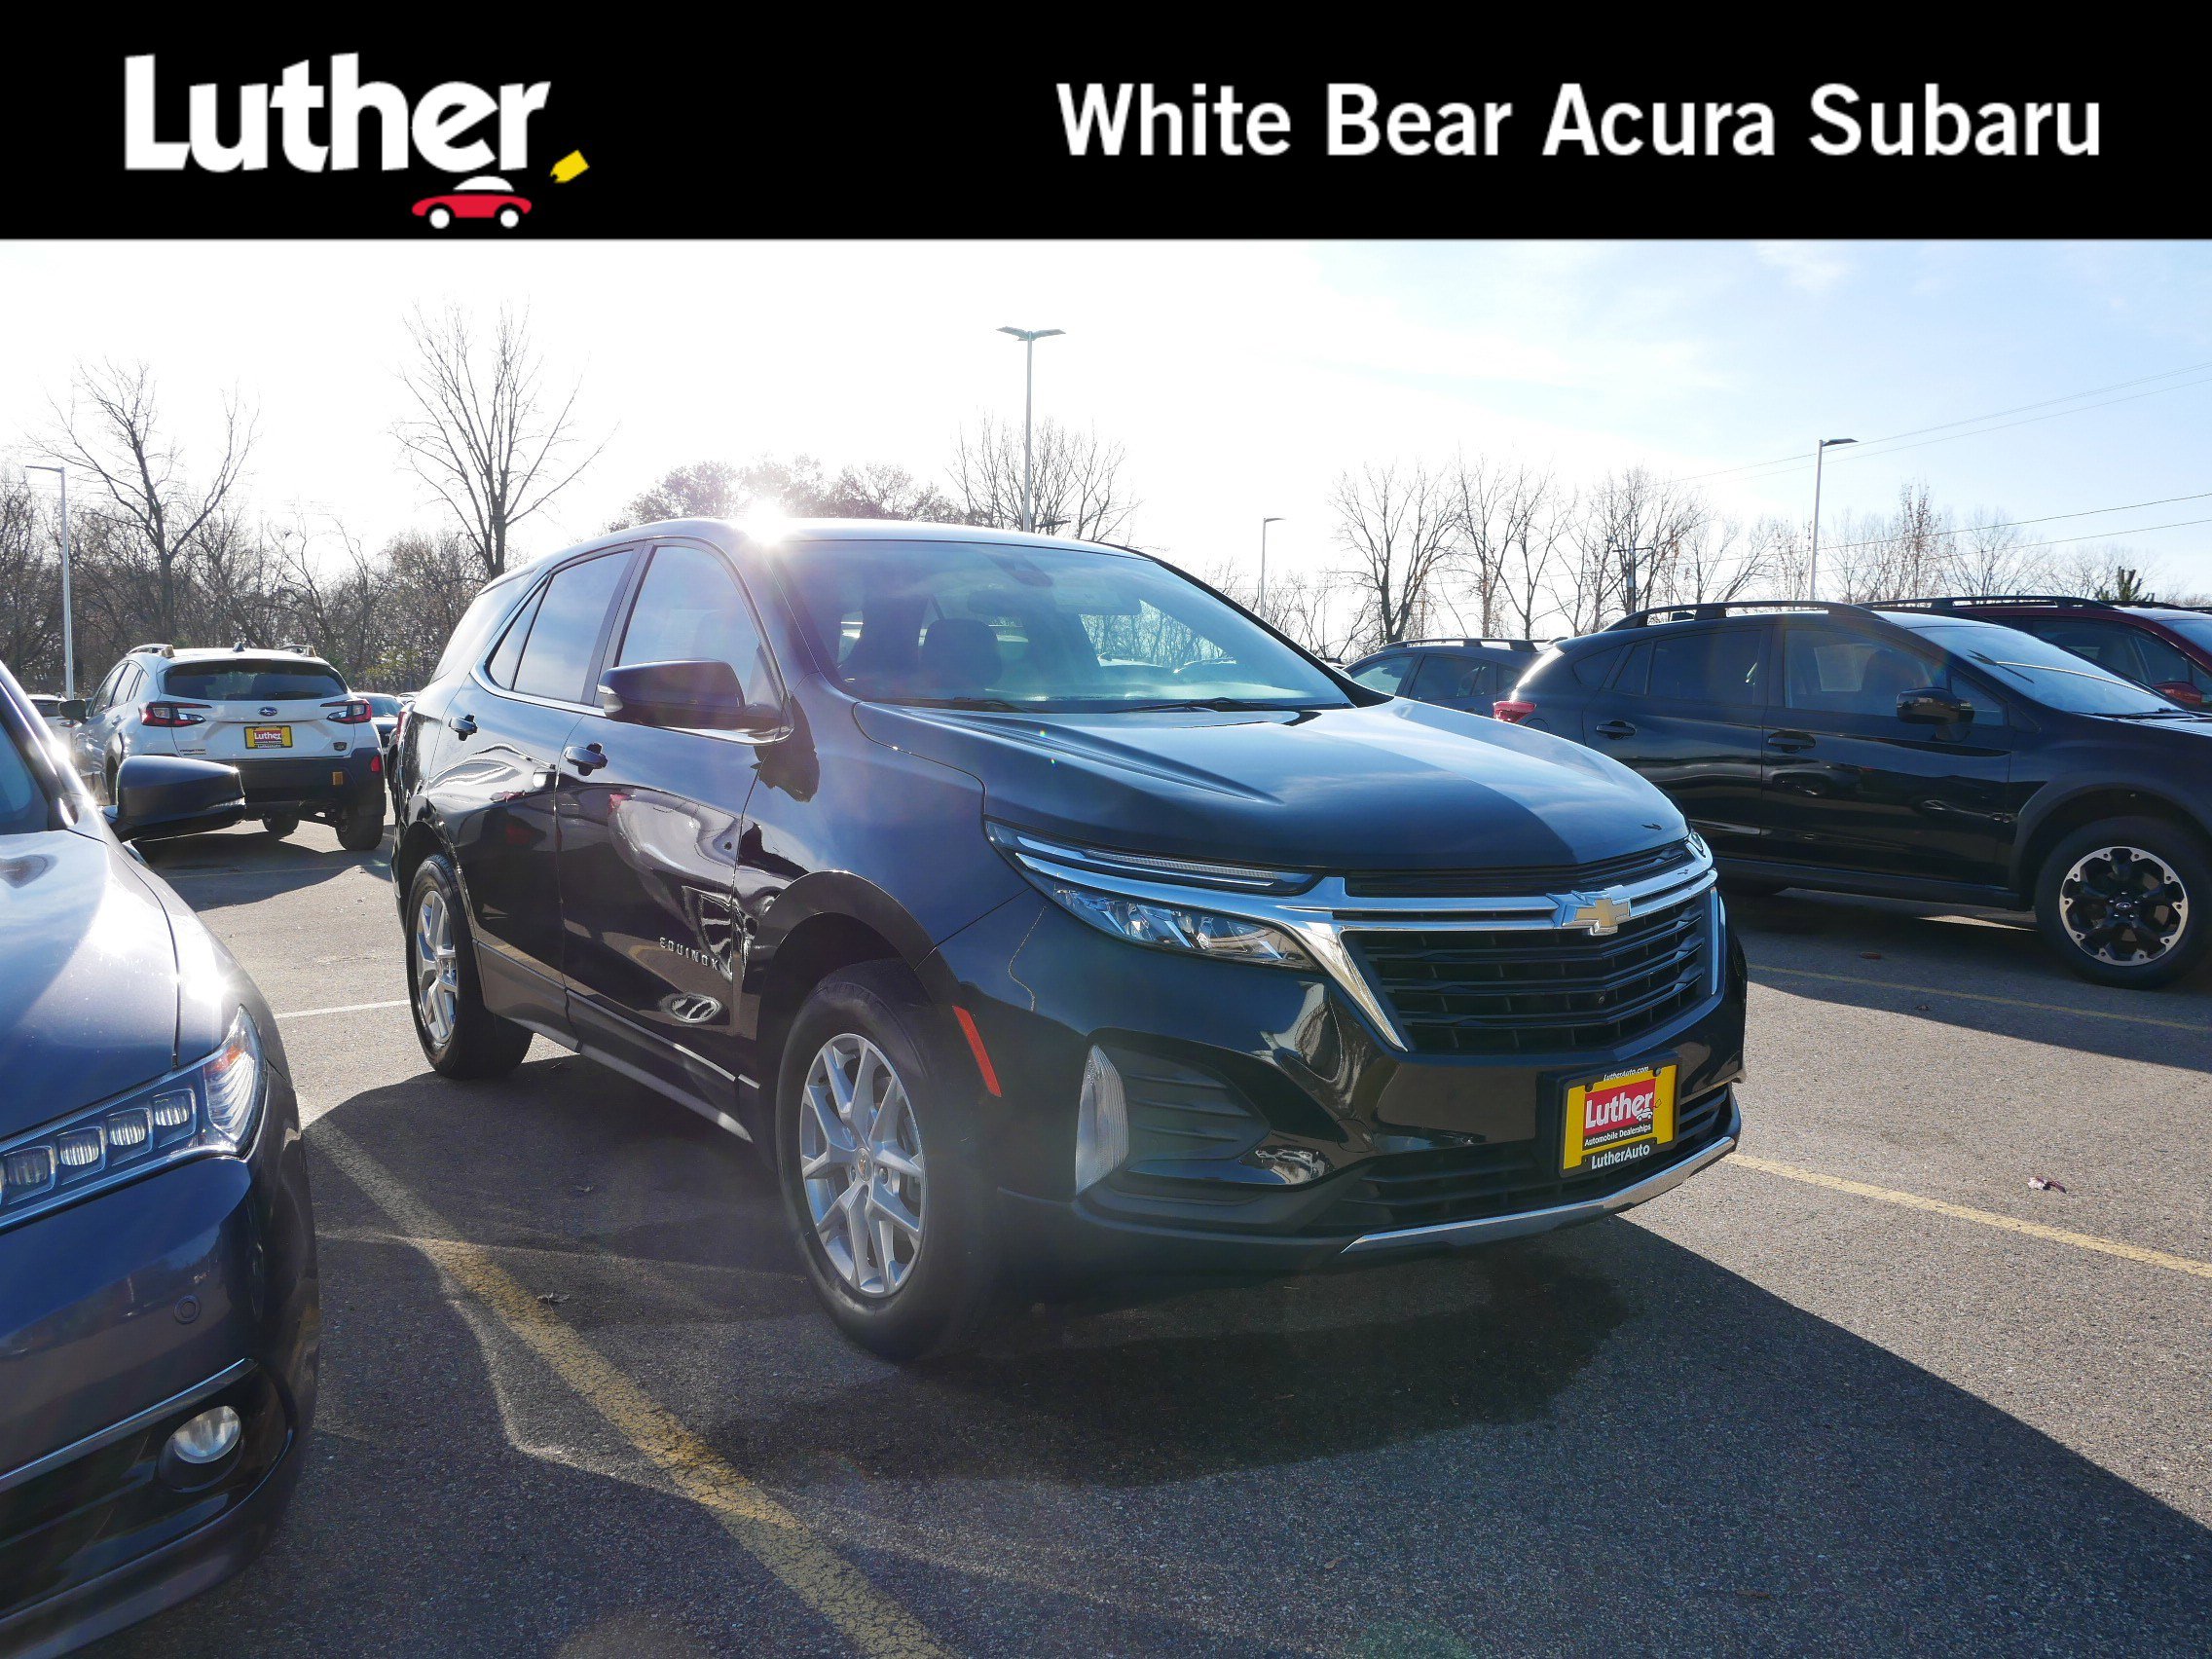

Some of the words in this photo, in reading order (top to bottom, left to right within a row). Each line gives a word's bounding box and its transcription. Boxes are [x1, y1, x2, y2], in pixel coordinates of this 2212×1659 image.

[659, 937, 720, 971] EQUINOX
[1604, 1066, 1649, 1082] LutherAuto.com
[1585, 1092, 1654, 1129] Luther
[1584, 1130, 1618, 1147] Automobile
[1619, 1124, 1652, 1138] Dealerships
[1591, 1143, 1650, 1170] LutherAuto
